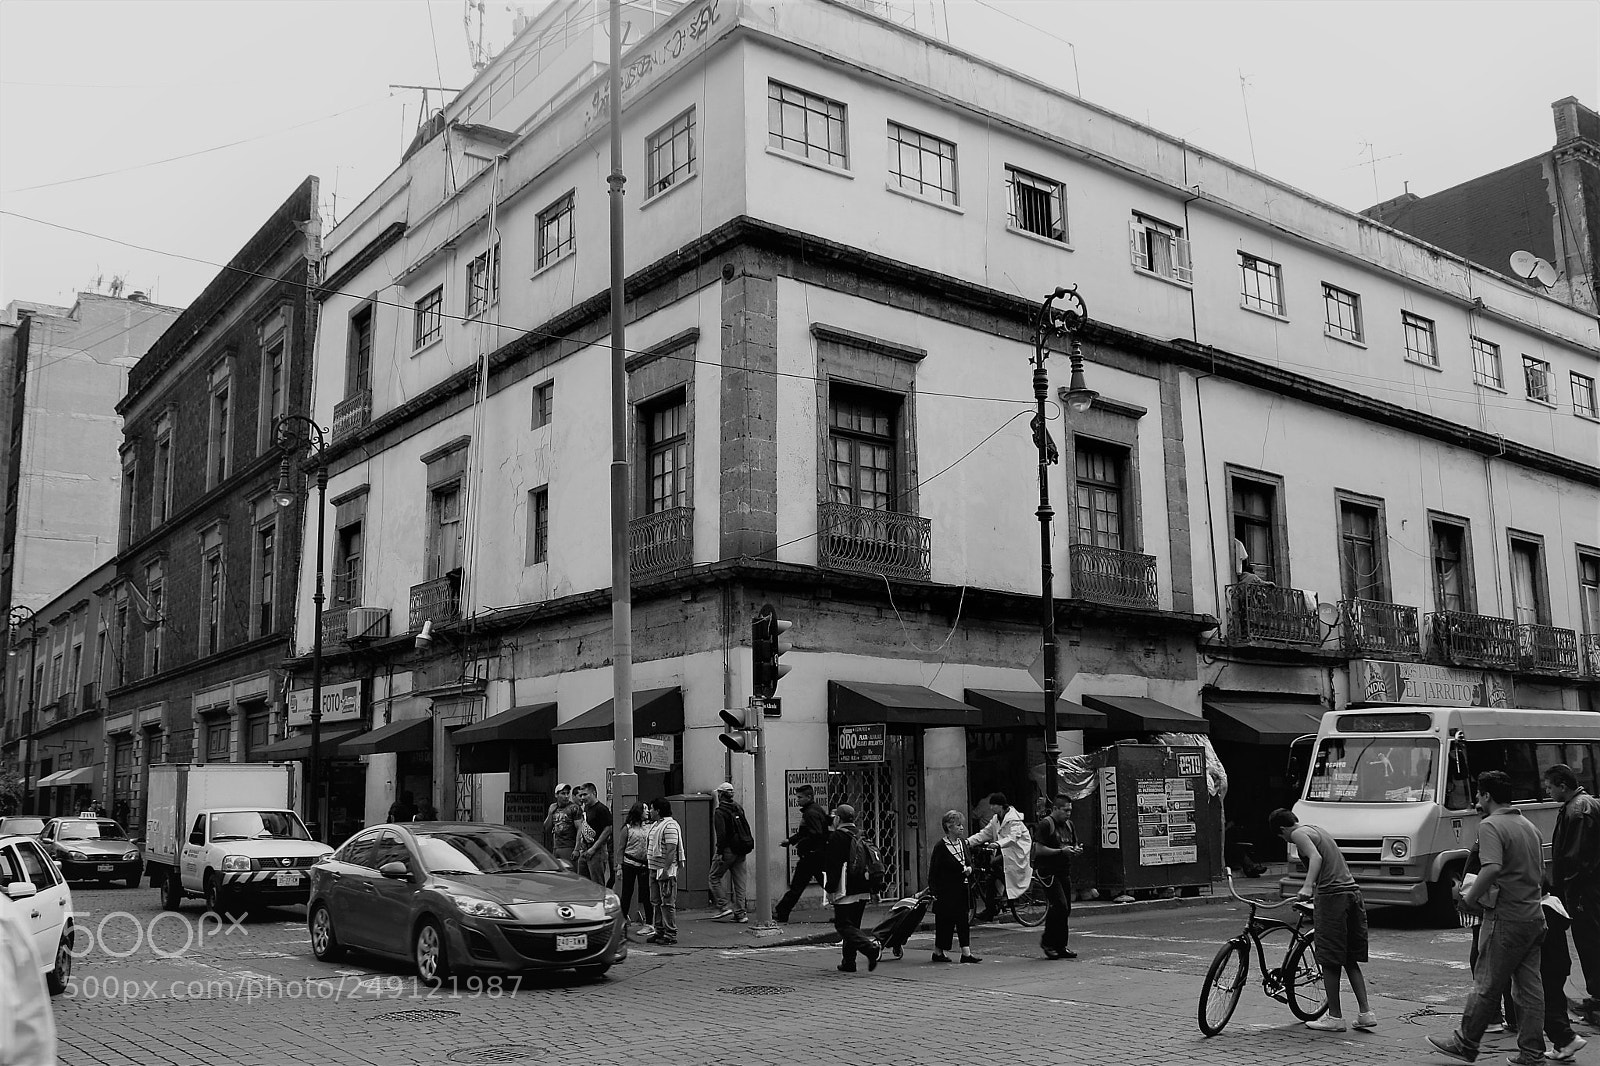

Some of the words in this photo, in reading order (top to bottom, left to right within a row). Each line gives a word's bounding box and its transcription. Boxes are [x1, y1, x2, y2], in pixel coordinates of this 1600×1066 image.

[1400, 663, 1464, 682] RESTAURANTE
[1466, 671, 1483, 684] BAR
[1365, 681, 1386, 698] INDIO
[1405, 680, 1420, 698] EL
[1423, 681, 1472, 703] JARRITO
[1489, 690, 1506, 706] INDIO
[322, 692, 340, 713] FOTO
[839, 733, 857, 750] ORO
[636, 749, 652, 764] ORO
[788, 772, 828, 784] COMPRUEBELO
[814, 786, 827, 795] PAGA
[906, 776, 917, 815] ORO
[1105, 771, 1119, 845] MILENIO
